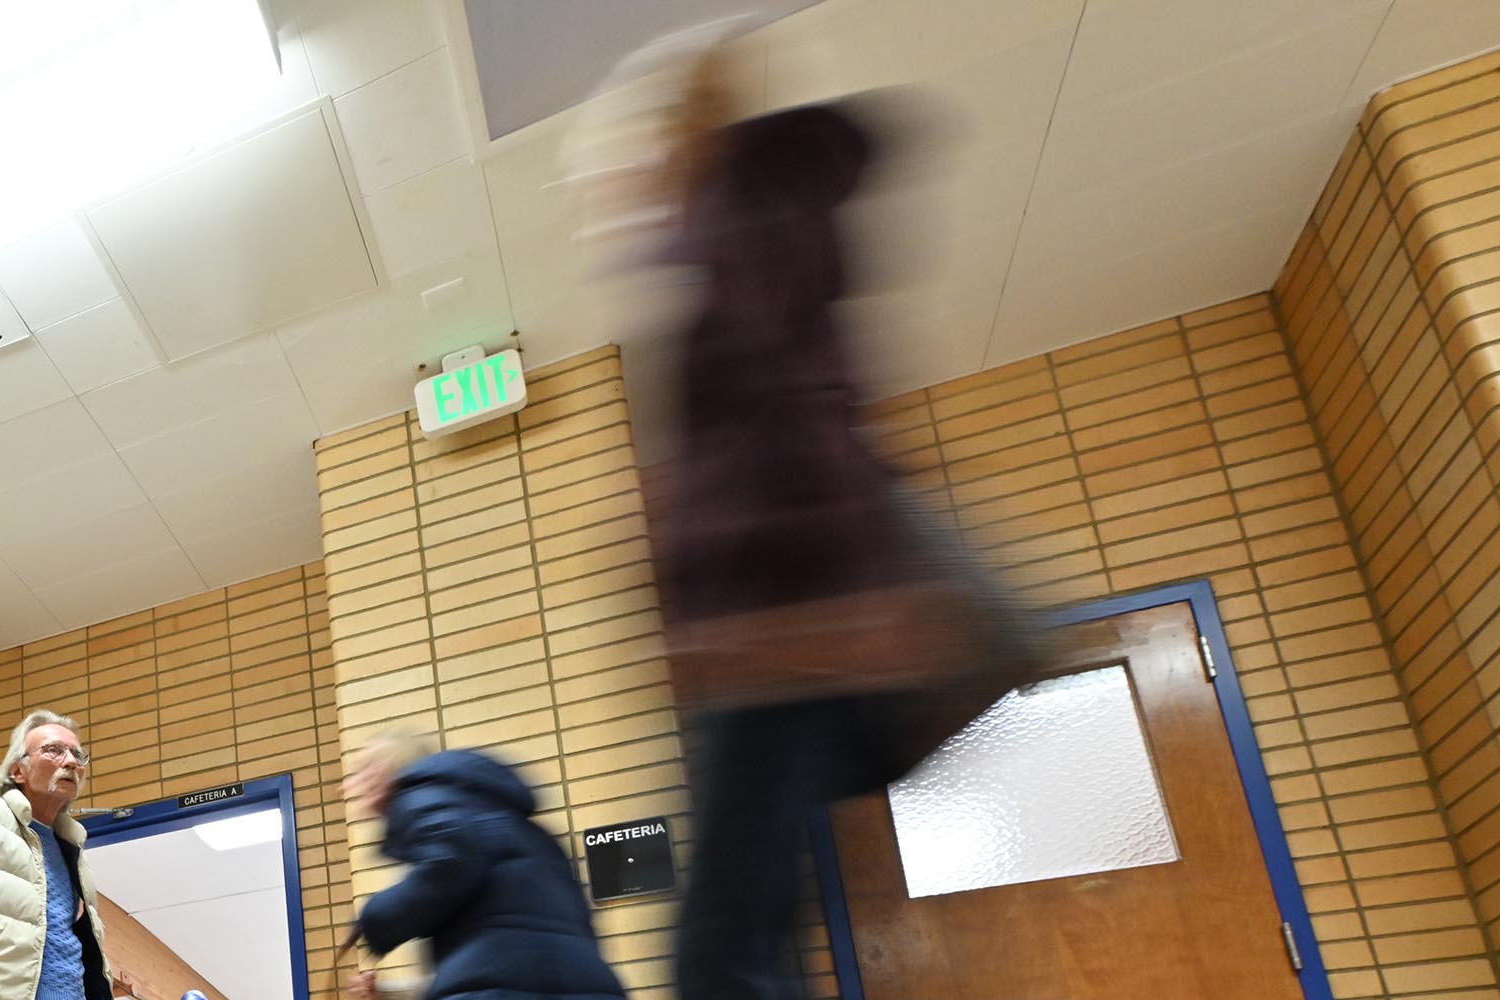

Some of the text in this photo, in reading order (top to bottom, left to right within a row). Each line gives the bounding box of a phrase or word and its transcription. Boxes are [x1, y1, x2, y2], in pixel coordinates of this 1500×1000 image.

[431, 354, 508, 424] EXIT
[184, 787, 237, 806] CAFETERIA A
[585, 823, 666, 846] CAFETERIA
